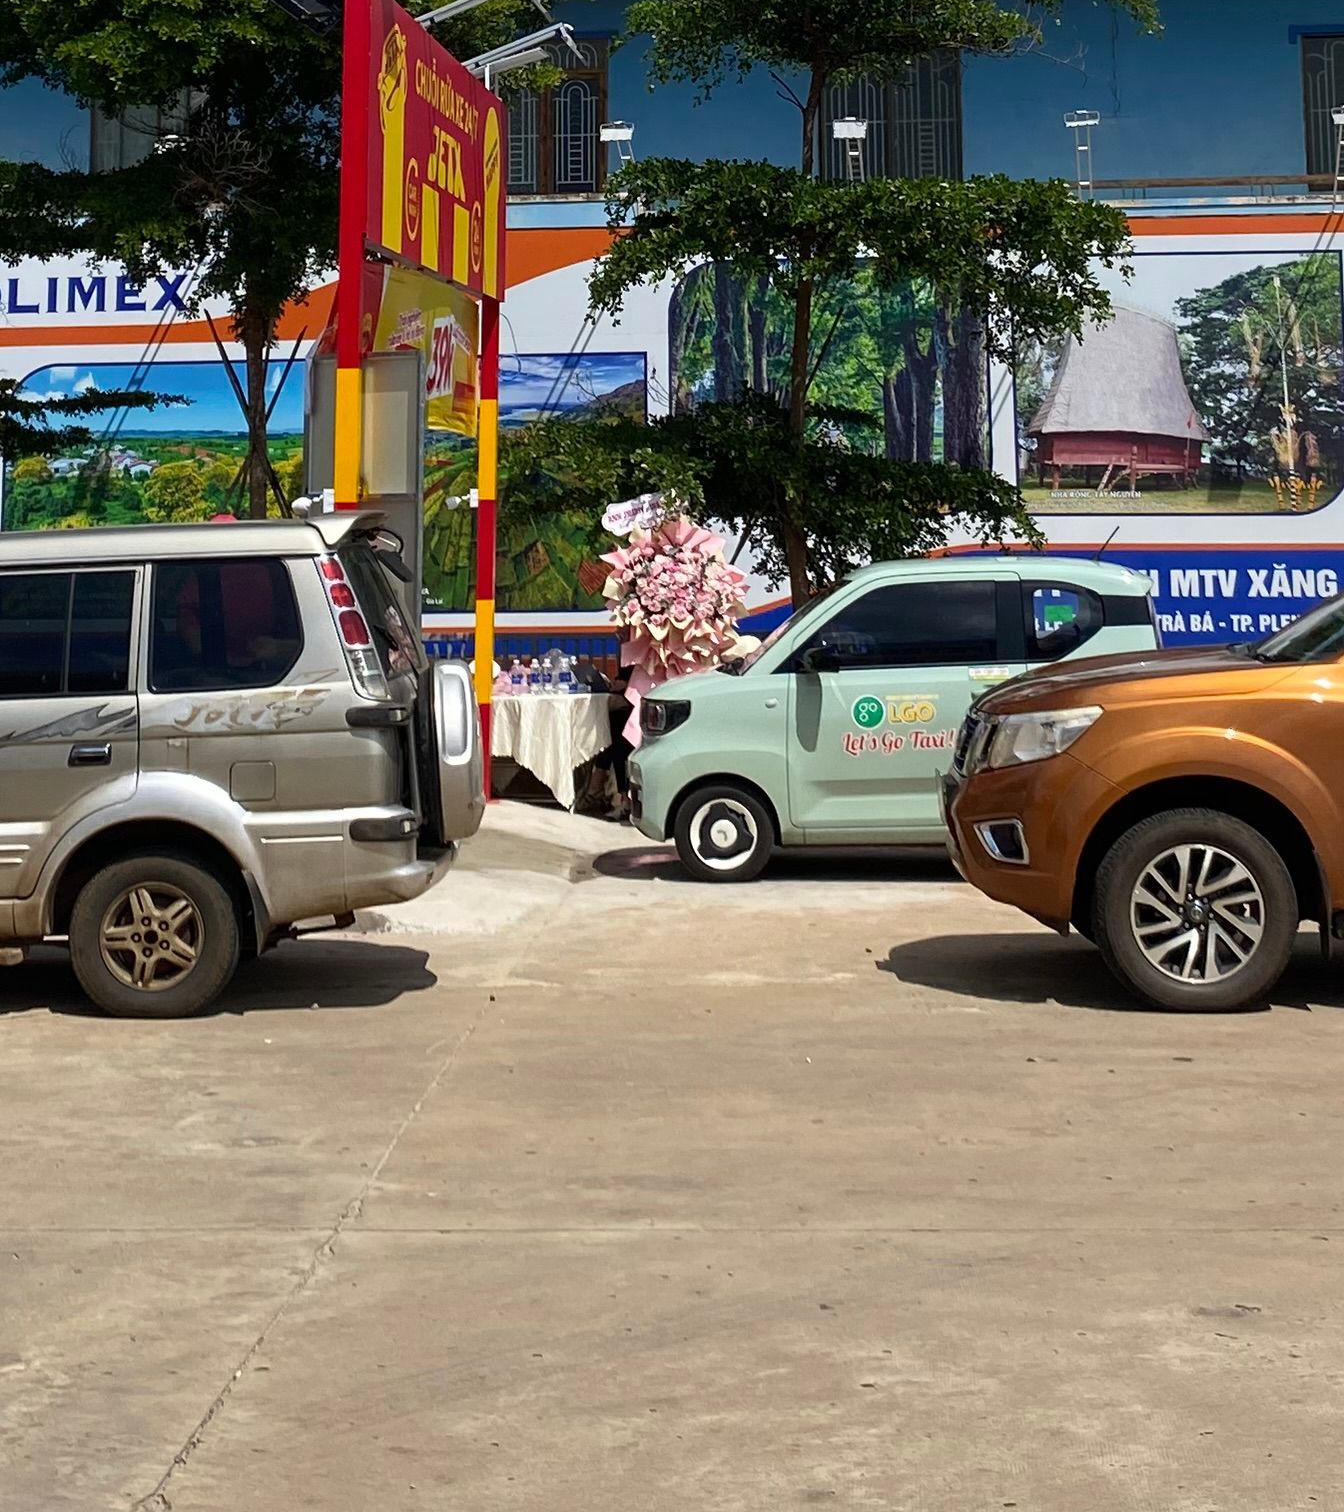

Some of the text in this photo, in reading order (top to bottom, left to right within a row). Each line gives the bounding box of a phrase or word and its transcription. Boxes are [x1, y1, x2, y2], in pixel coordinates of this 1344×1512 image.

[427, 125, 466, 202] JETX
[1169, 568, 1238, 598] MTV
[1247, 562, 1339, 598] XĂNG
[1190, 613, 1215, 633] BÁ
[1230, 614, 1256, 633] TP.
[888, 701, 936, 725] LGO
[843, 731, 879, 756] Let's
[881, 731, 904, 754] Go
